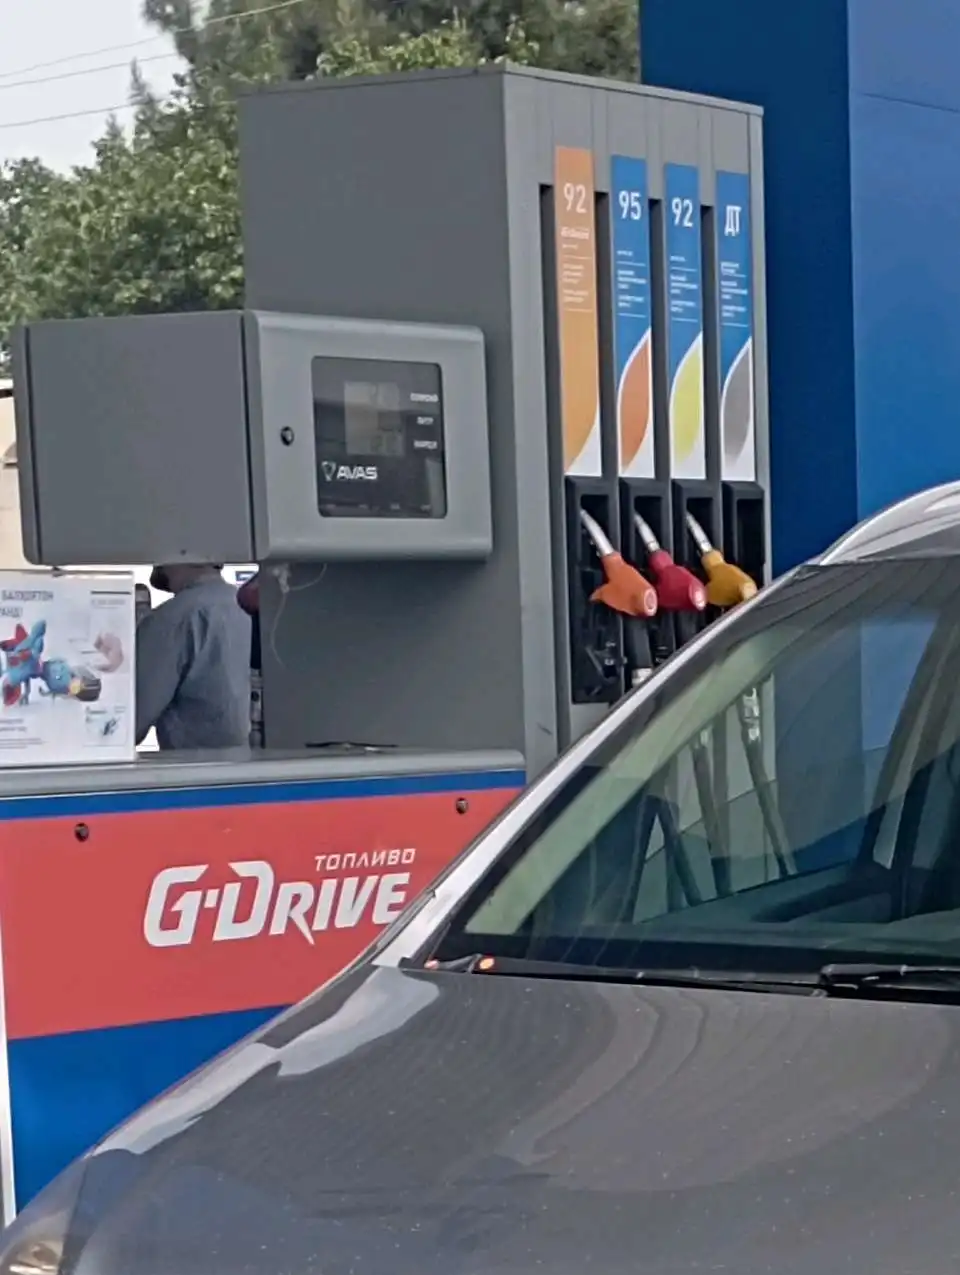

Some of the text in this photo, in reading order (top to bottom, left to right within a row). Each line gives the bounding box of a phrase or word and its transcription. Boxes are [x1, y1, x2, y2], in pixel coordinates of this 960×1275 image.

[563, 182, 588, 214] 92
[618, 189, 642, 221] 95
[671, 197, 694, 228] 92
[724, 205, 742, 237] ДТ
[336, 465, 378, 481] AVAS
[314, 848, 417, 872] ТОПЛИВО
